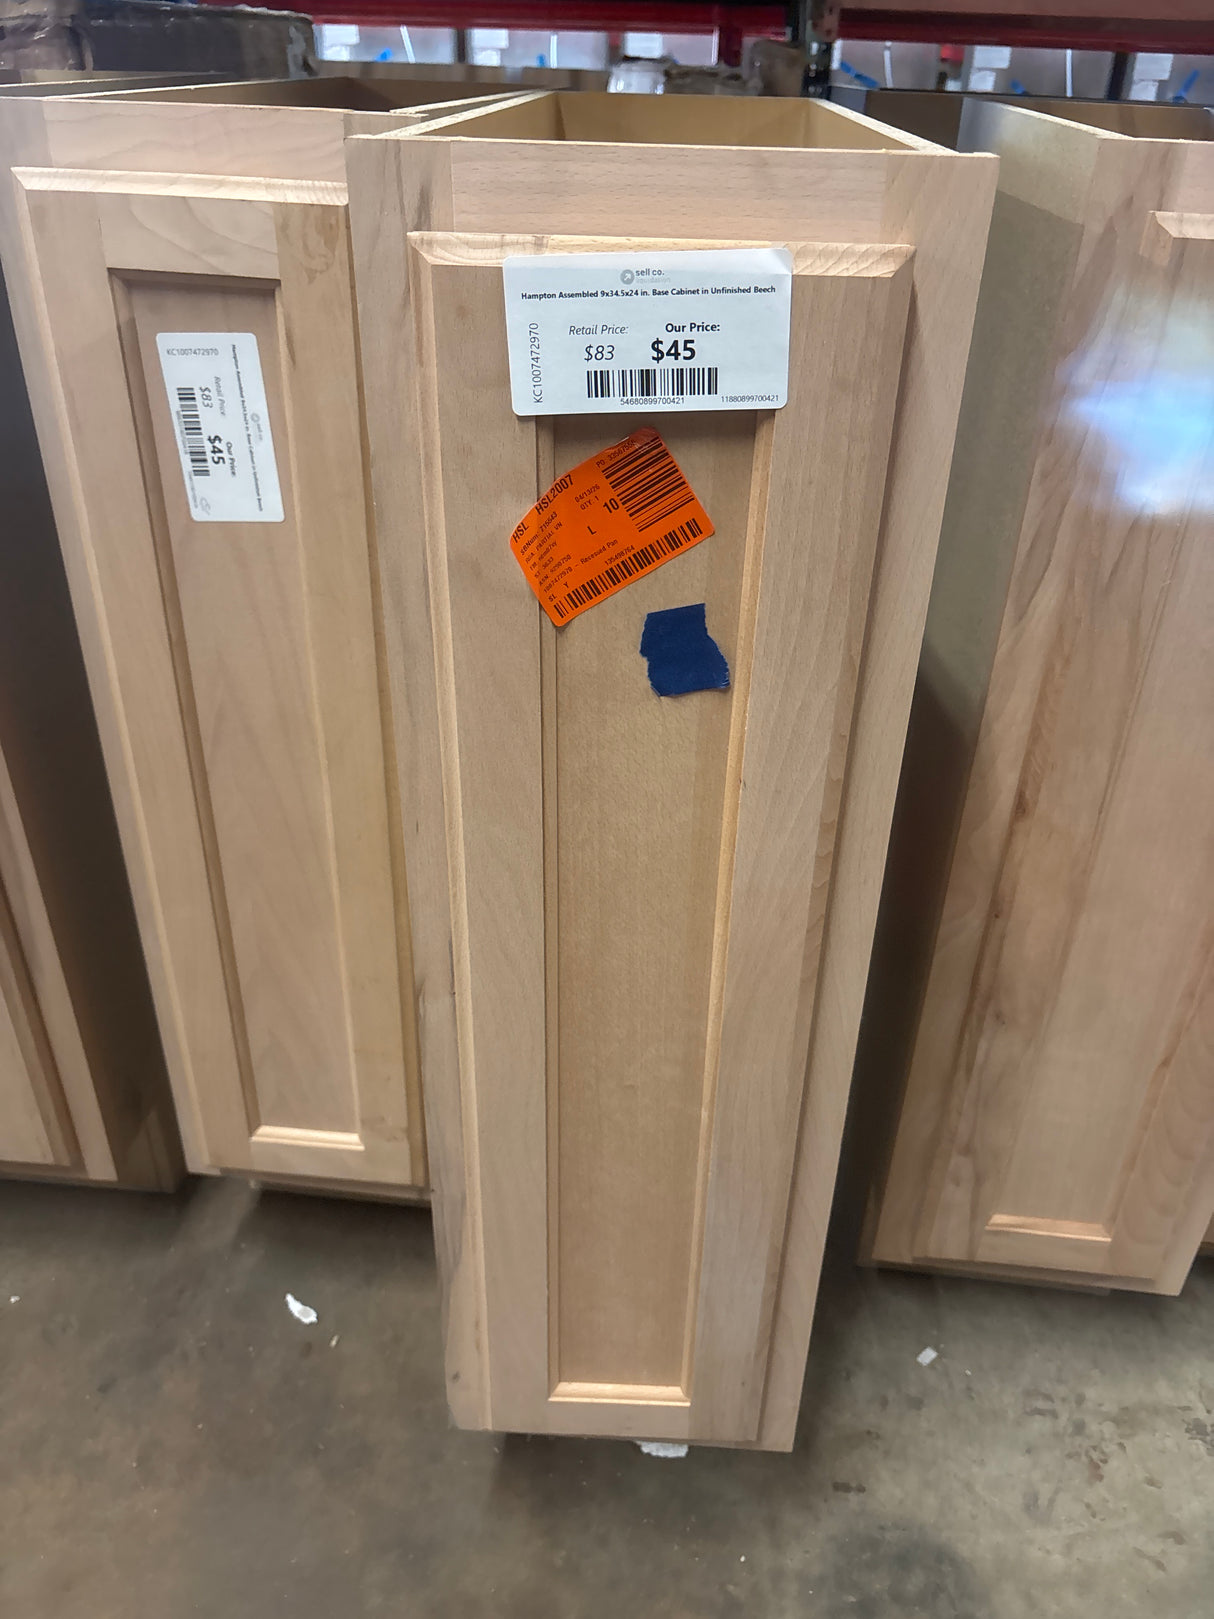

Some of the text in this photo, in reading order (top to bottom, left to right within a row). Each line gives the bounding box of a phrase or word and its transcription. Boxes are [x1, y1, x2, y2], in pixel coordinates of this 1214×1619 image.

[635, 268, 650, 277] sell
[521, 292, 556, 301] Hampton
[558, 291, 598, 299] Assembled
[600, 289, 639, 298] 9x34.5x24
[640, 289, 650, 297] in.
[652, 288, 669, 296] Base
[671, 288, 700, 296] Cabinet
[711, 285, 752, 295] Unfinished
[753, 285, 776, 293] Beech
[569, 324, 629, 335] Retail Price:
[665, 321, 720, 333] Our Price:
[584, 343, 615, 363] $83
[650, 337, 696, 364] $45
[528, 322, 543, 404] KC1007472970
[199, 386, 214, 409] $83
[620, 397, 685, 406] 54680899700421
[207, 434, 226, 465] $45
[225, 441, 233, 456] Our
[535, 473, 574, 515] HSL2007
[603, 498, 620, 514] 10
[512, 521, 529, 543] HSL
[587, 525, 597, 535] L
[563, 581, 569, 589] Y
